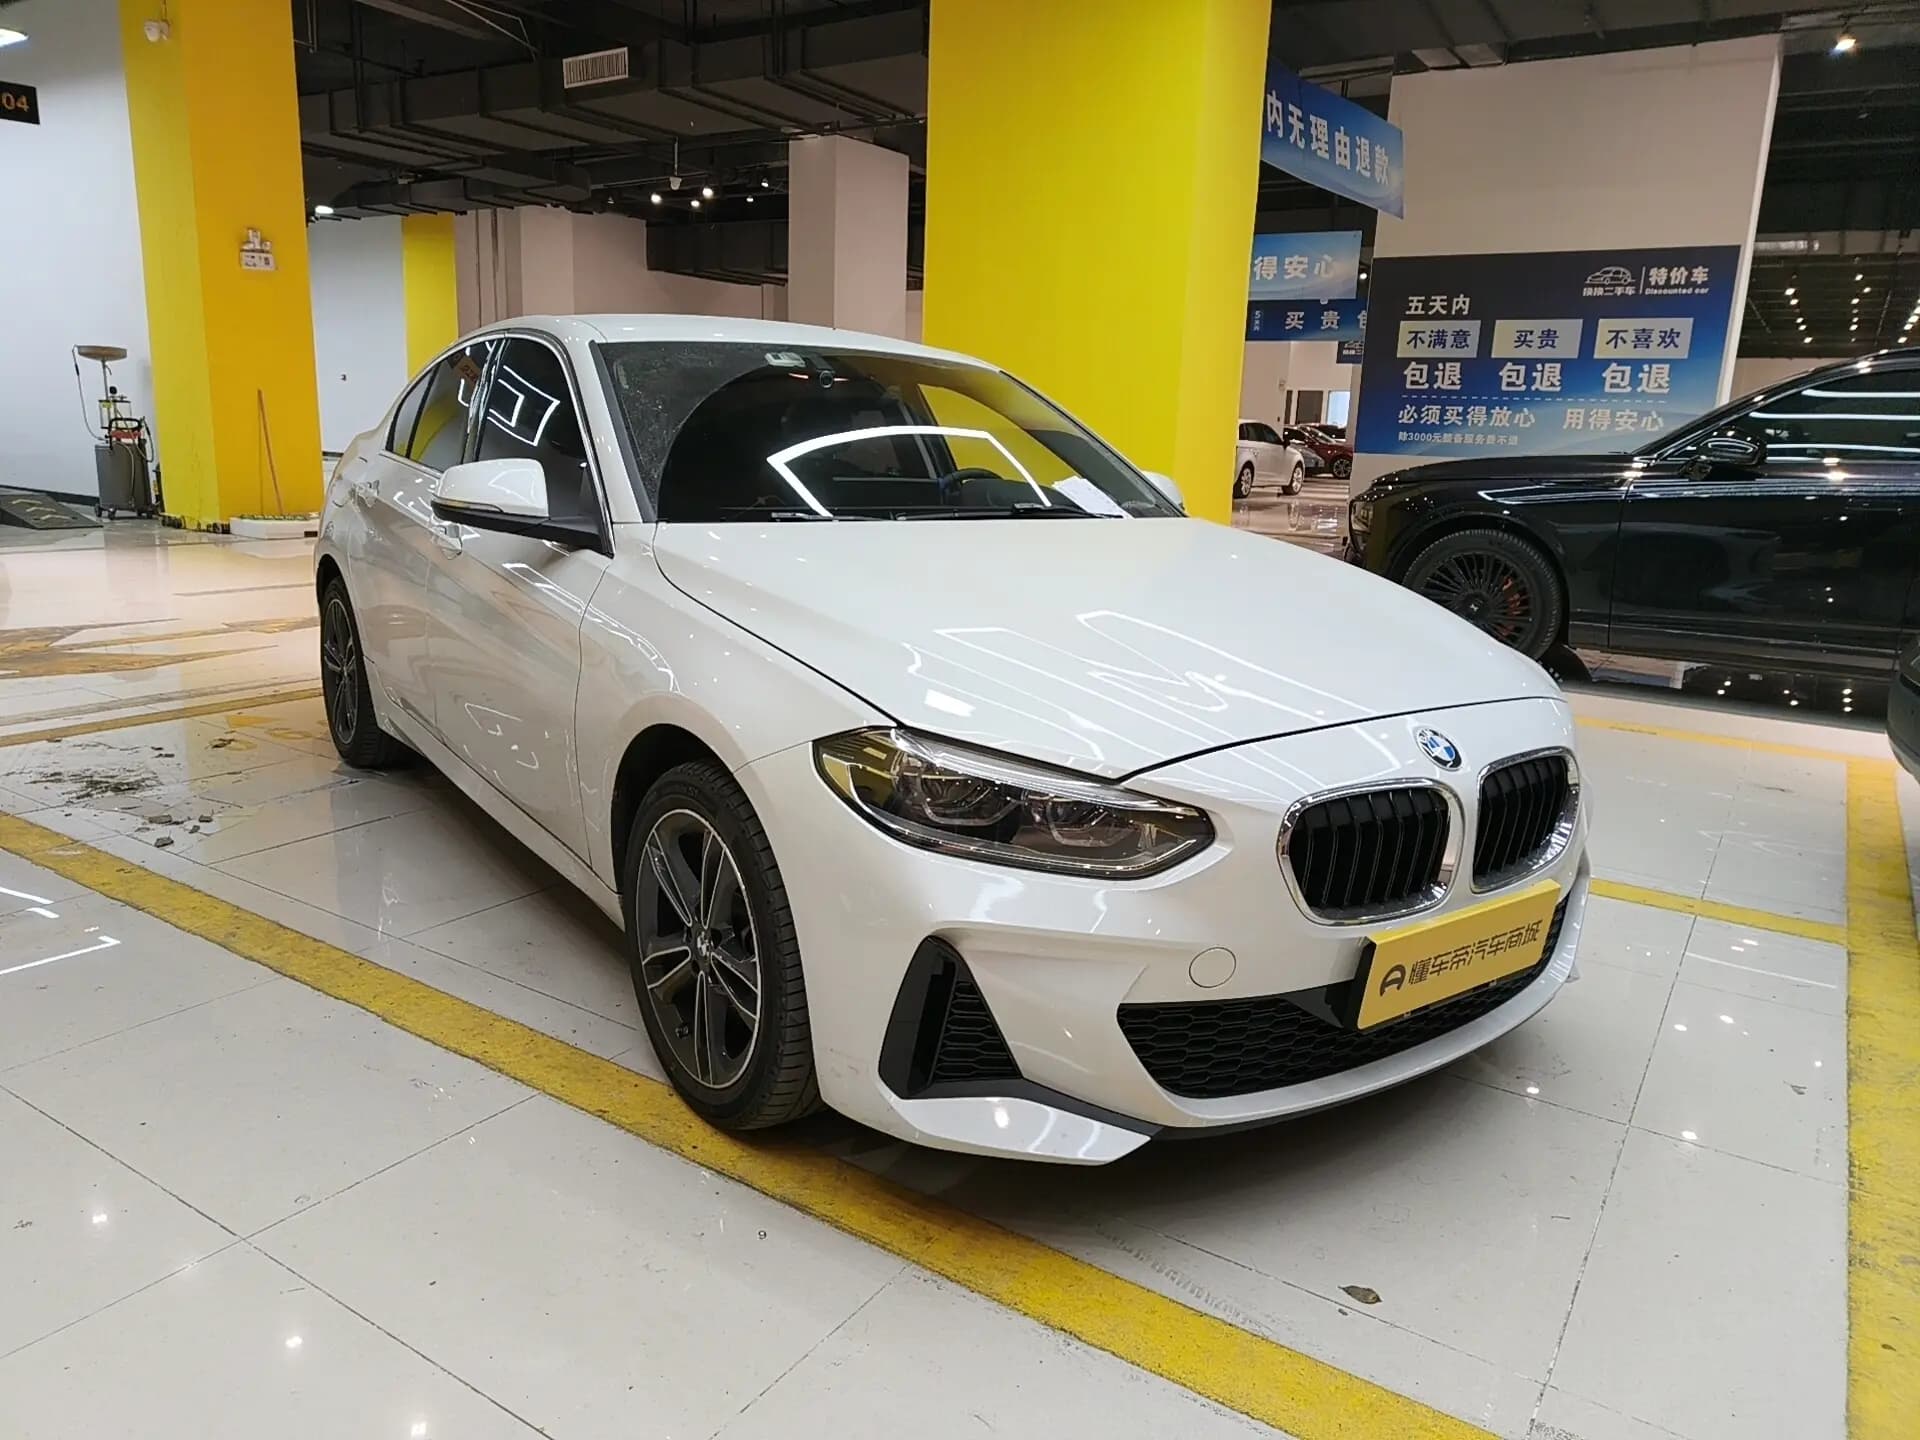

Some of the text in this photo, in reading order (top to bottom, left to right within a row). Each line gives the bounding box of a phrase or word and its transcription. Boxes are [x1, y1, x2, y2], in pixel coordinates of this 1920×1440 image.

[1266, 89, 1390, 185] 内无理由退款
[1253, 253, 1335, 281] 得安心
[1648, 265, 1710, 286] 特价车
[1405, 293, 1471, 316] 五天内
[1406, 327, 1682, 350] 不满意 买贵 不喜欢
[1403, 360, 1671, 394] 包退 包退 包退
[1397, 404, 1665, 432] 必须买得放心 用得安心
